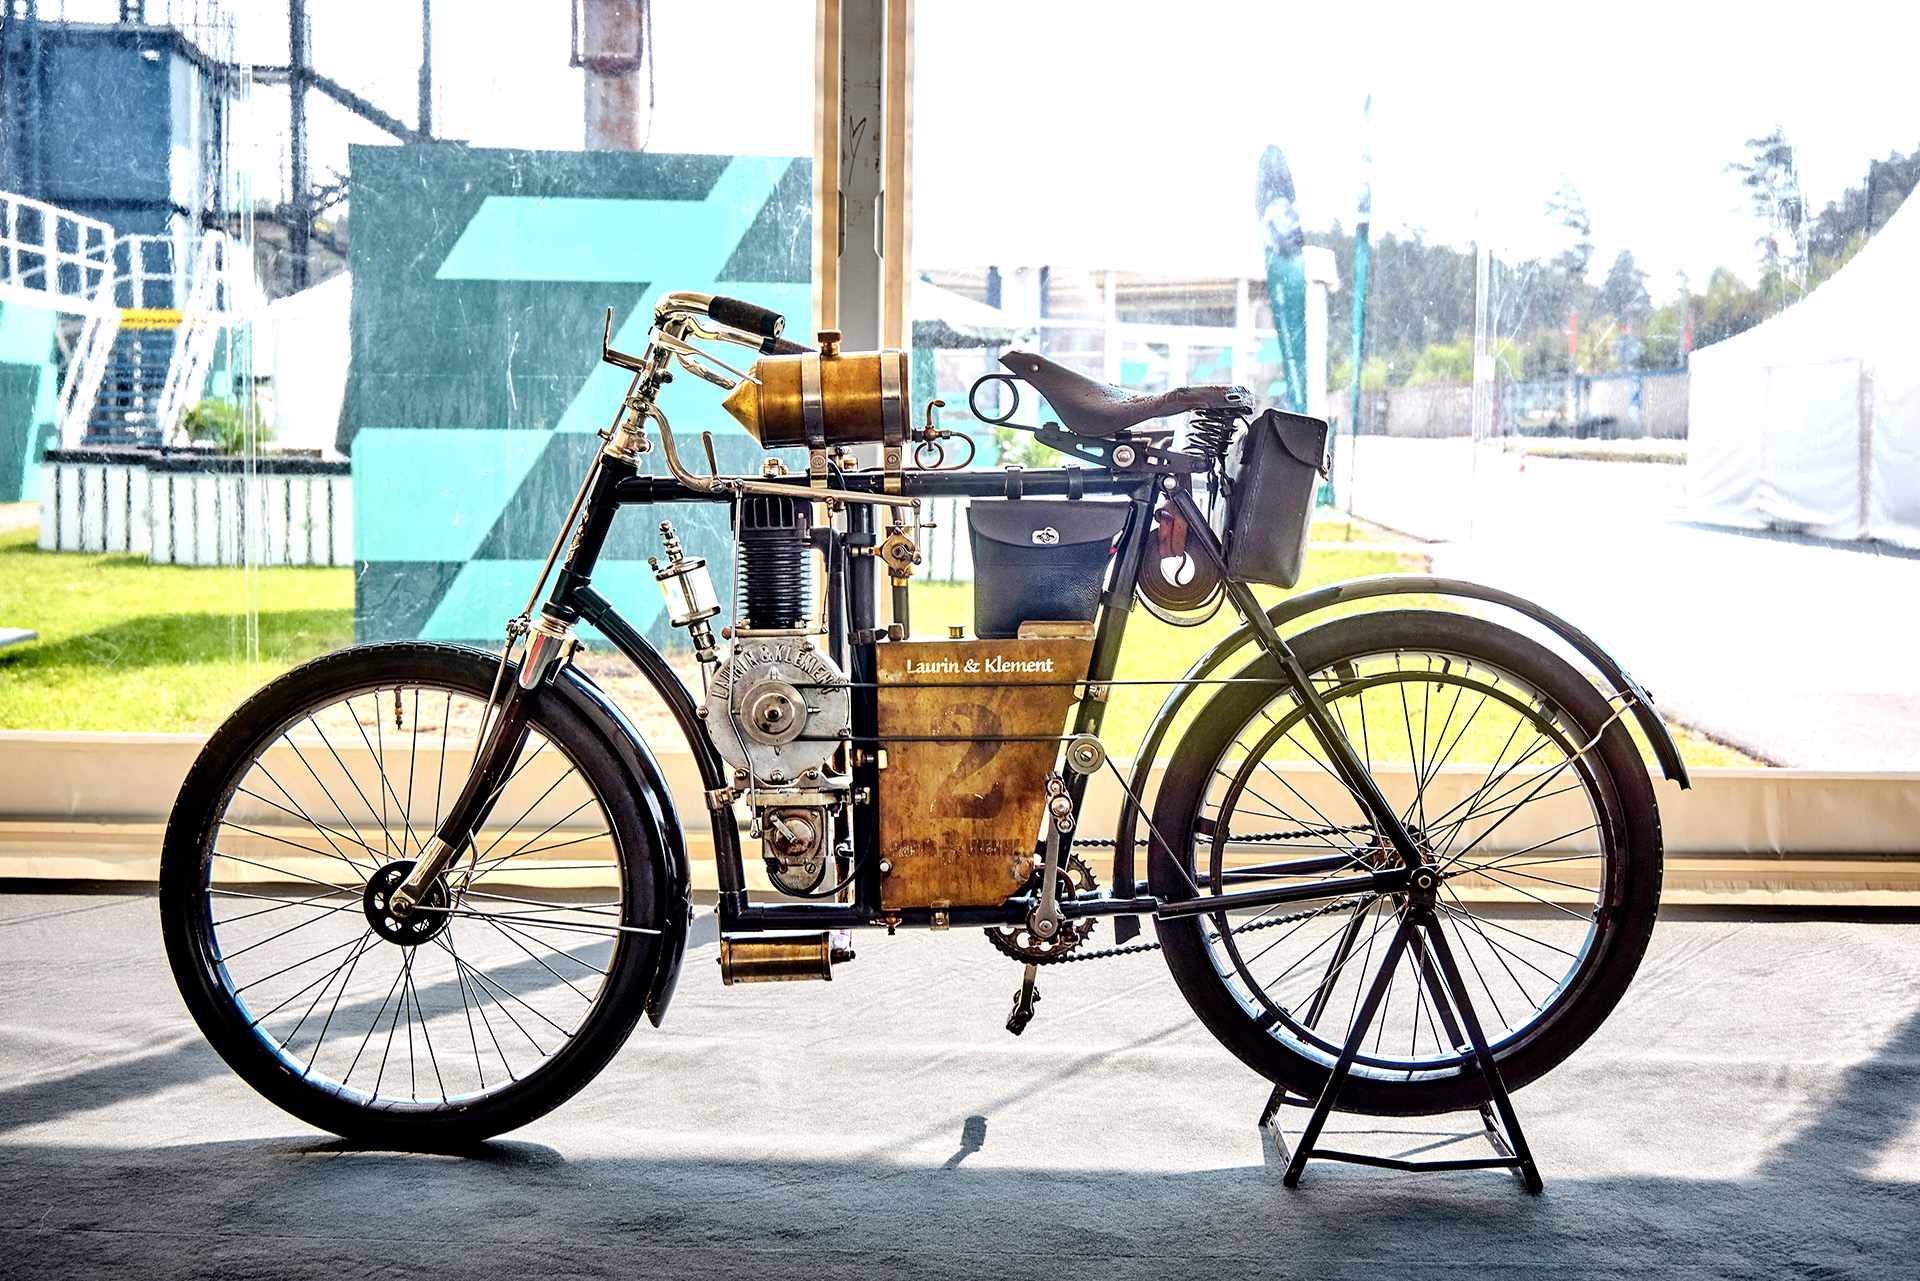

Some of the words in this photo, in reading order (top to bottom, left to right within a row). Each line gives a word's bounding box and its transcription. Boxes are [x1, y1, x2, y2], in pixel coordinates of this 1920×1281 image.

[759, 642, 773, 663] &
[906, 657, 960, 673] Laurin
[963, 658, 980, 673] &
[984, 655, 1054, 673] Klement
[930, 702, 1005, 819] 2
